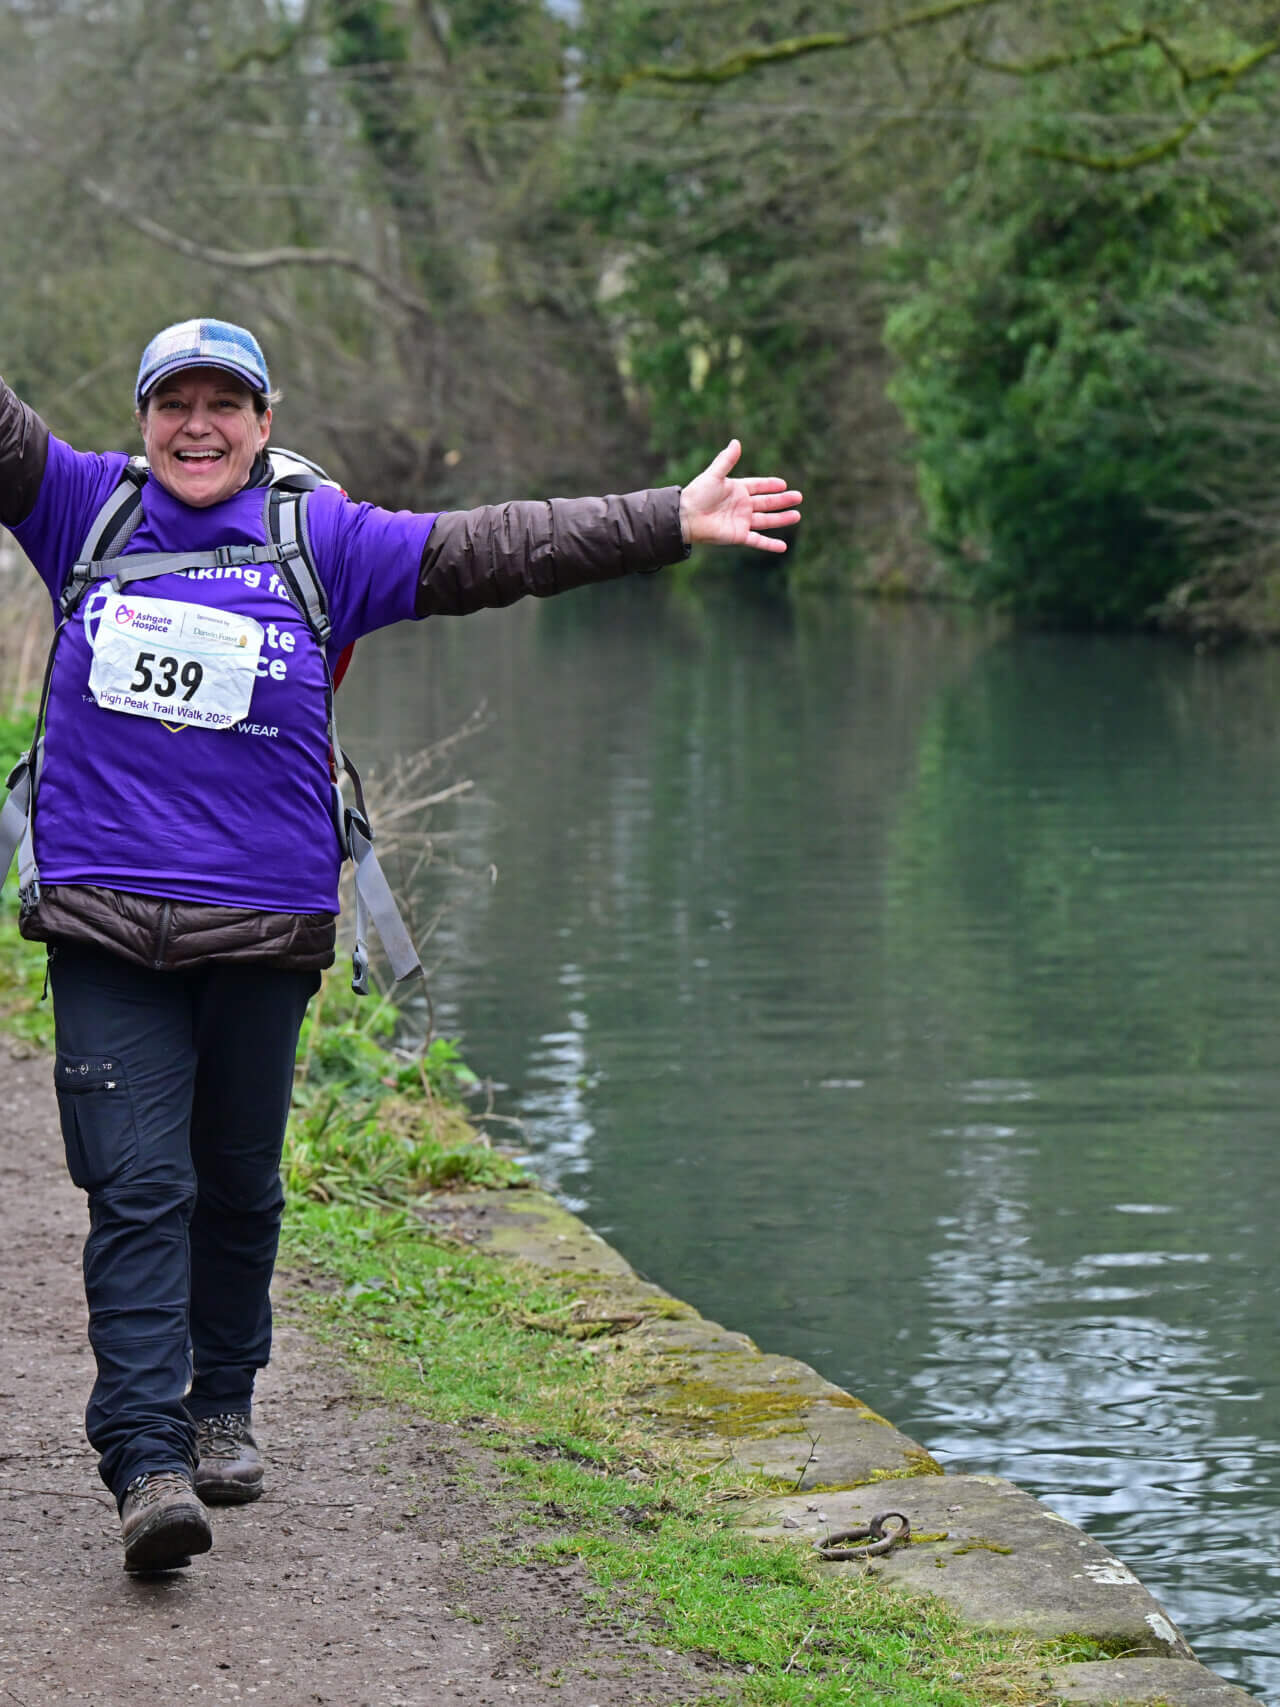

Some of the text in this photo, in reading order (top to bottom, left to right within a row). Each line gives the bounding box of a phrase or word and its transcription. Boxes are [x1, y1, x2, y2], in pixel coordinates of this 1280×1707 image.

[174, 567, 290, 600] lking fo
[131, 620, 169, 633] Hospice
[136, 612, 173, 626] Ashgate
[130, 652, 204, 702] 539
[100, 691, 233, 725] High Peak Trail Walk 2025
